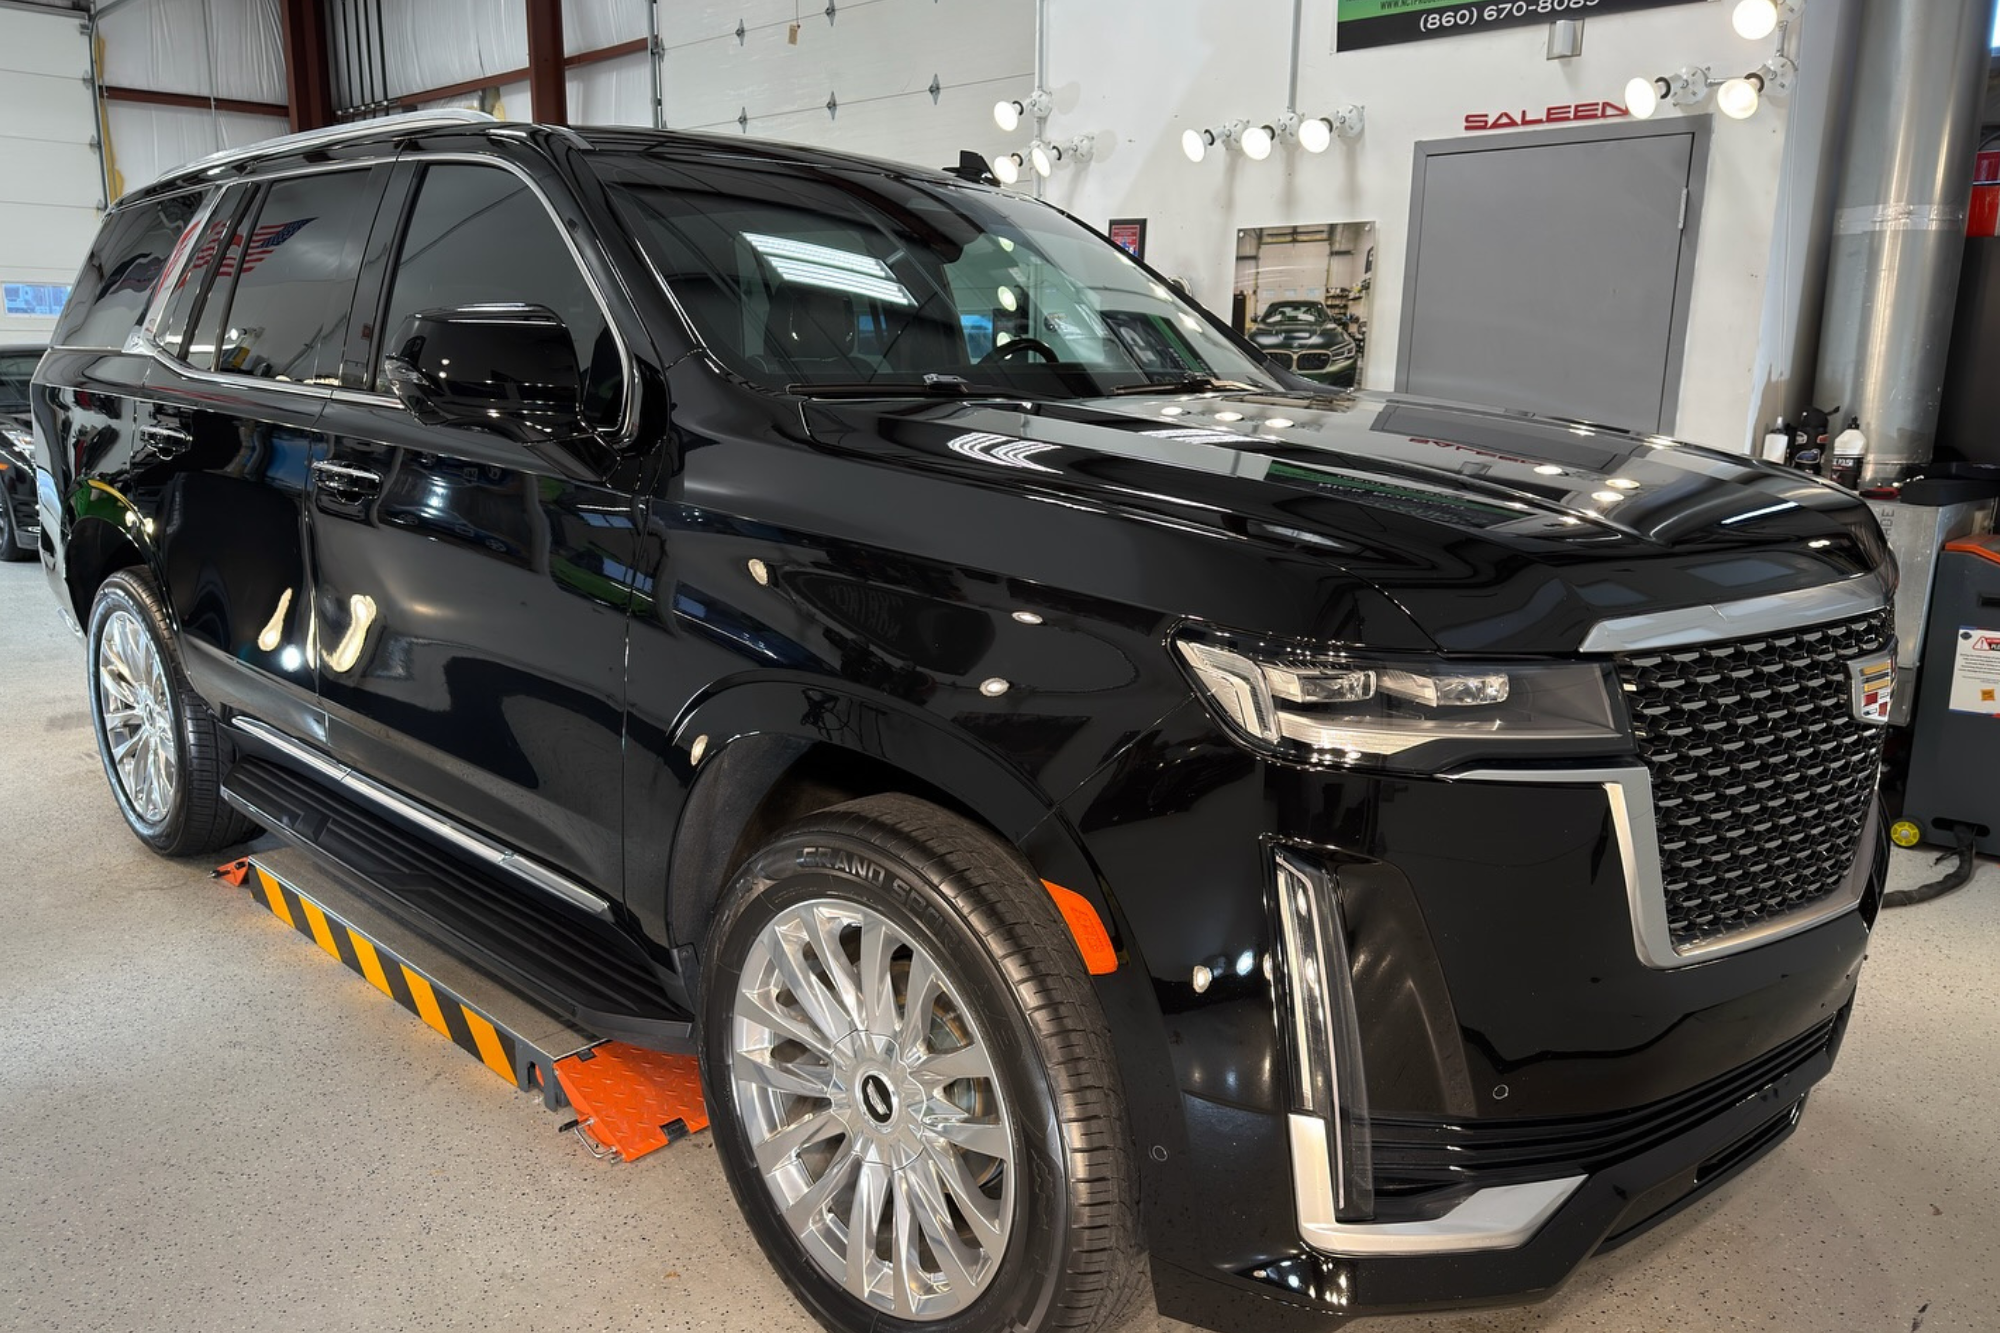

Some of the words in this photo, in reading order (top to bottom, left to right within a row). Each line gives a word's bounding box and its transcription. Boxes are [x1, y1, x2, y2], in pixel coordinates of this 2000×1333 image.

[1420, 7, 1478, 32] (860)
[1464, 101, 1629, 131] SALEEN
[797, 847, 887, 888] GRAND
